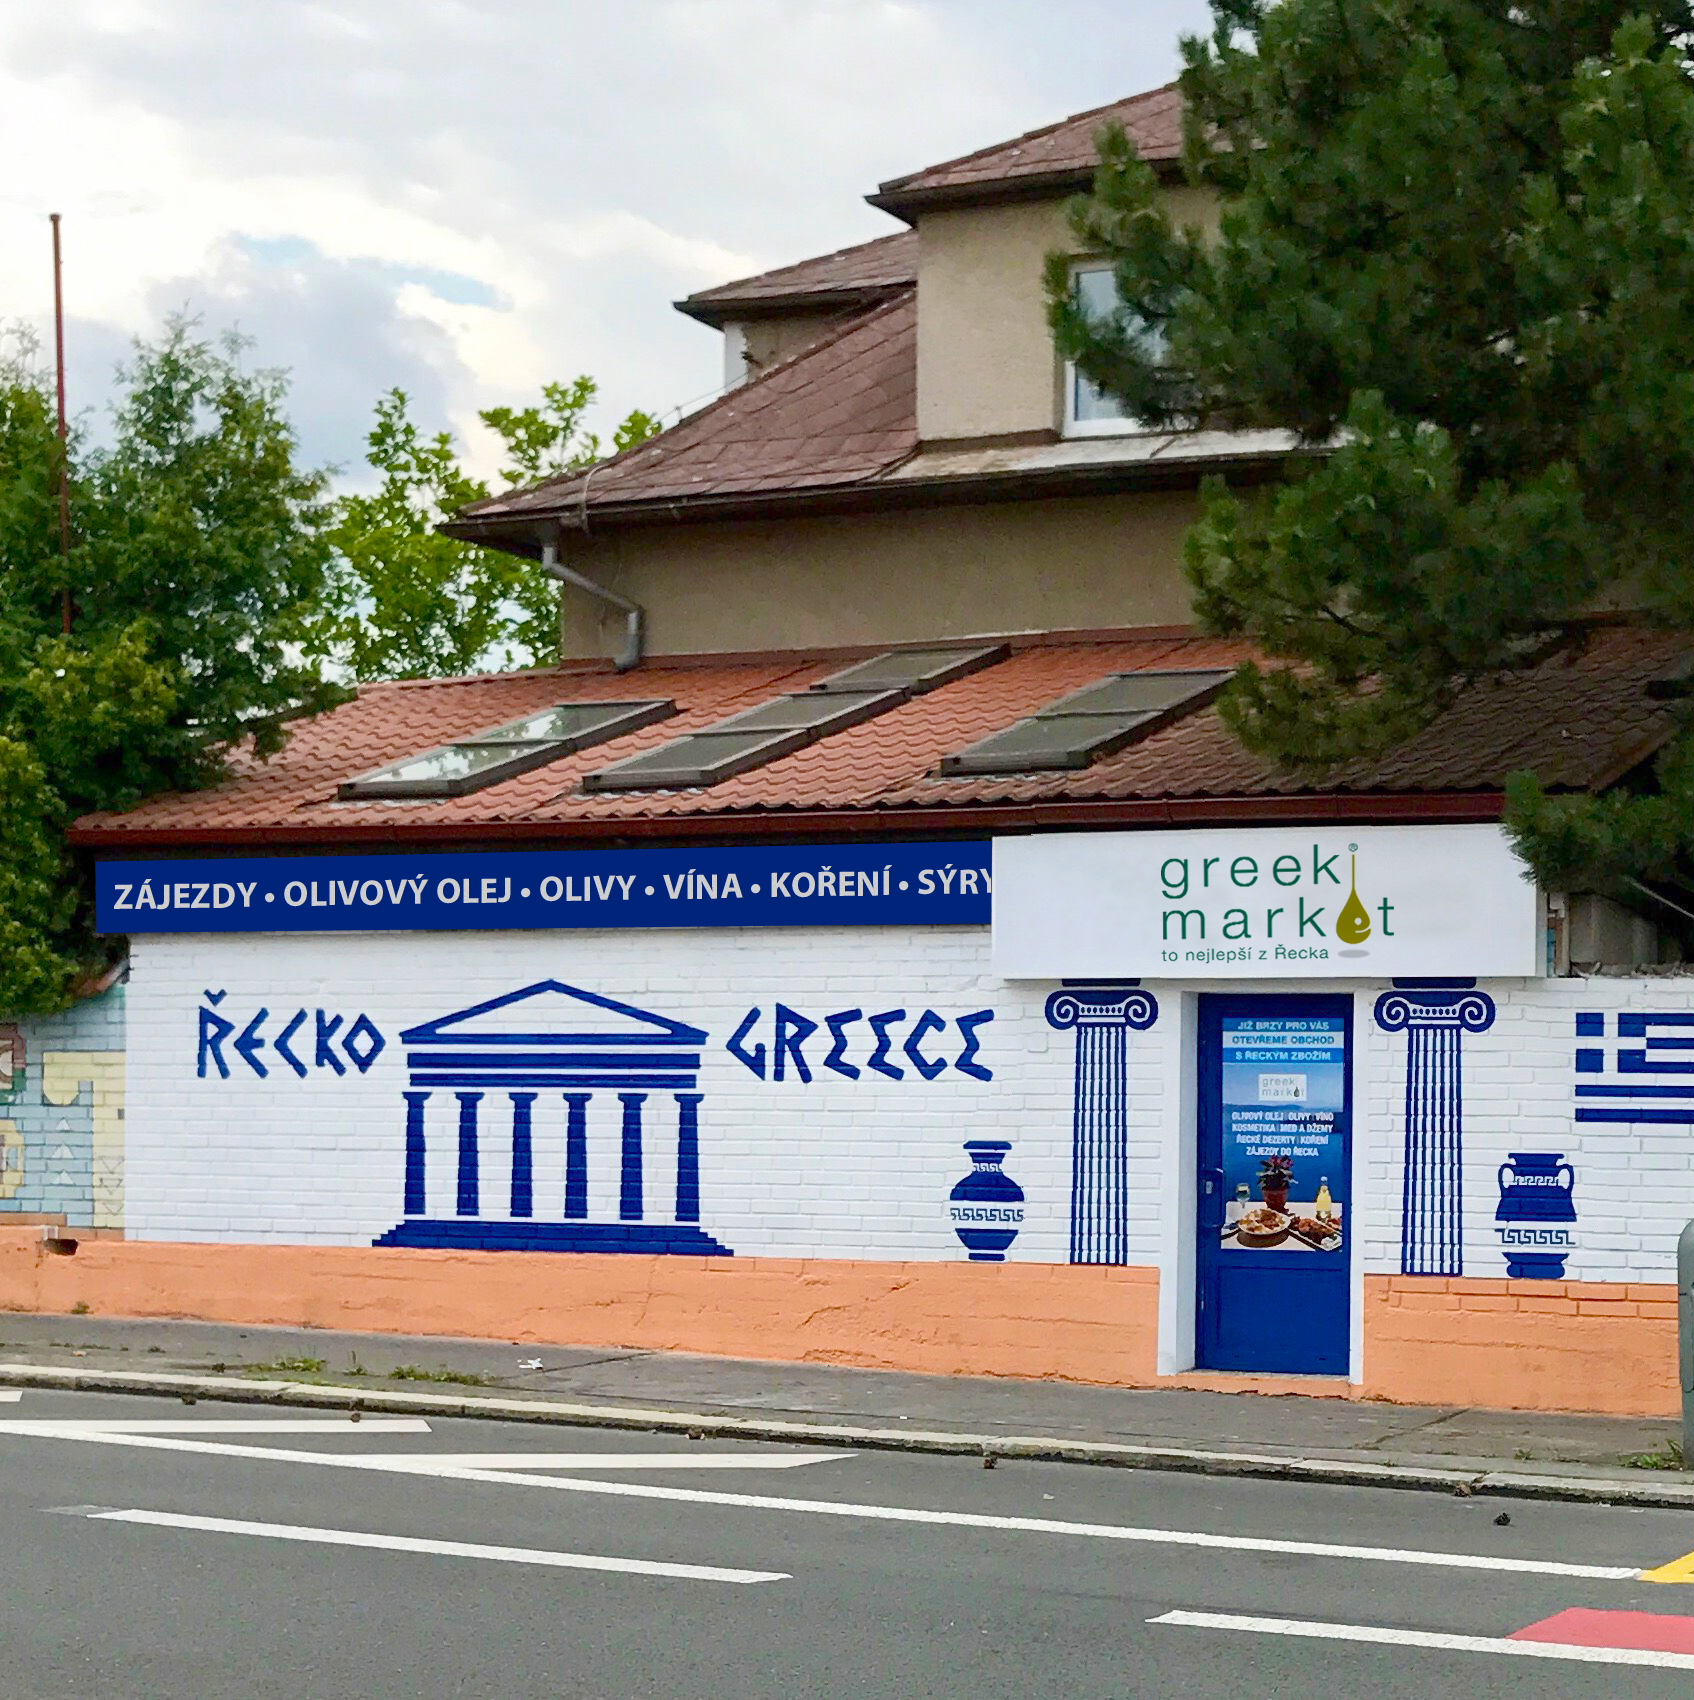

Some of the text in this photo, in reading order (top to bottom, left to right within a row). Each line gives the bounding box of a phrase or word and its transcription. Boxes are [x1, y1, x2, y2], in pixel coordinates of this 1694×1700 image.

[1161, 844, 1341, 899] greek
[113, 863, 993, 910] ZÁJEZDY OLIVOVÝ OLEJ OLIVY VÍNA KOŘENÍ SÝRY
[1162, 895, 1395, 944] market
[1161, 944, 1330, 964] to nejlepší z Řecka
[197, 989, 386, 1079] ŘECKO
[1237, 1020, 1330, 1030] JIŽ BRZY PRO VÁS
[1231, 1034, 1335, 1045] OTEVŘEME OBCHOD
[1235, 1050, 1332, 1061] S ŘECKÝM ZBOŽÍM
[1262, 1077, 1296, 1088] greek
